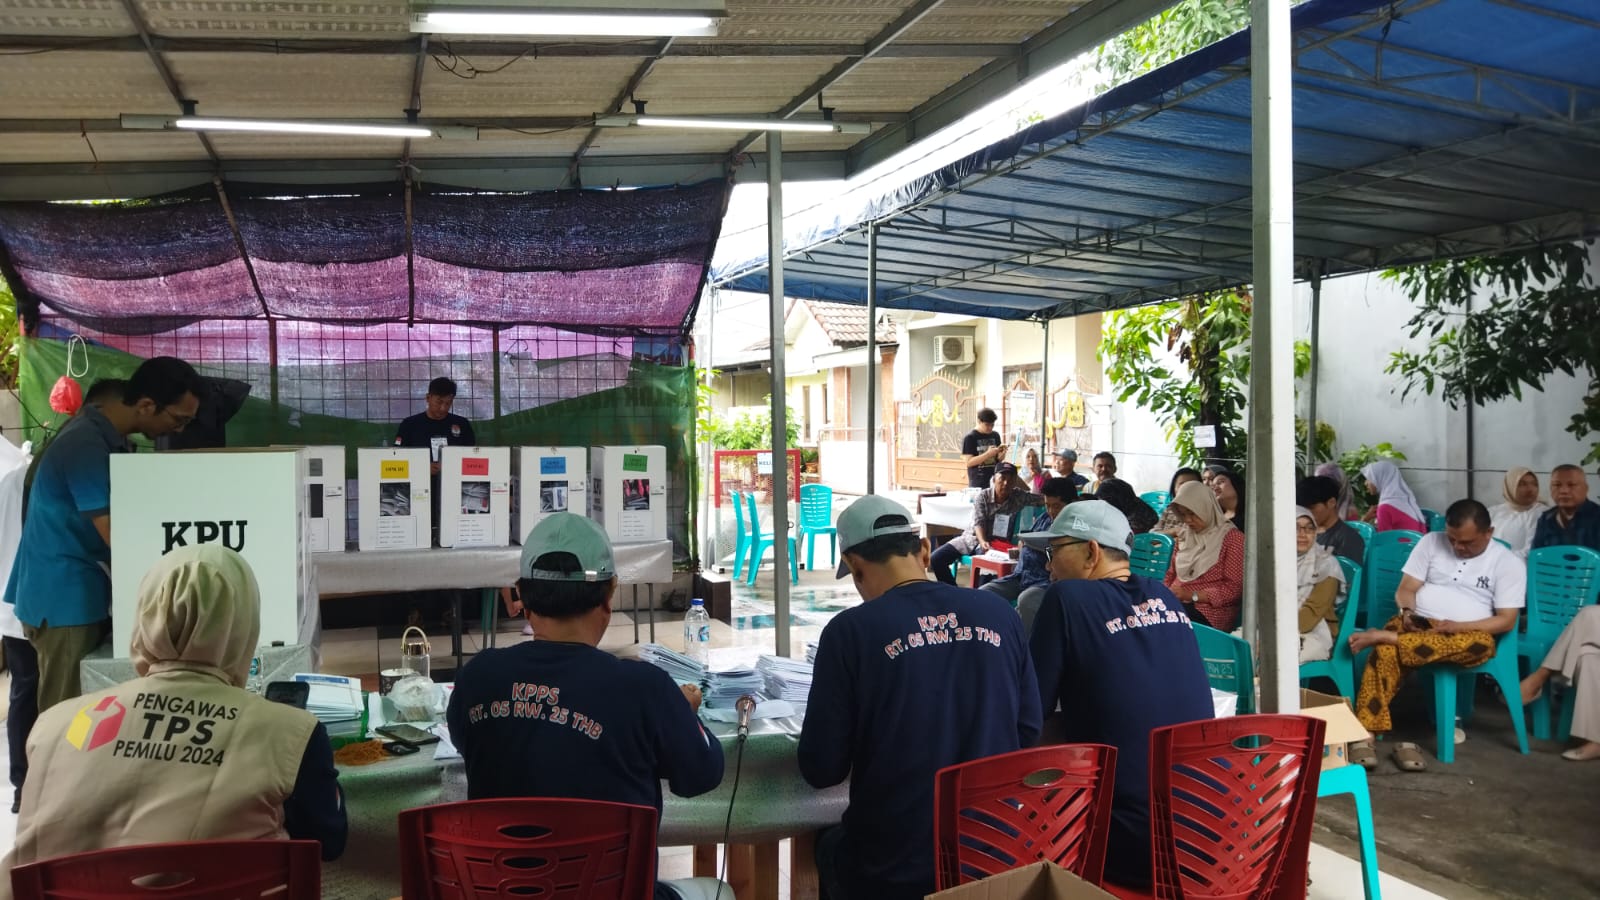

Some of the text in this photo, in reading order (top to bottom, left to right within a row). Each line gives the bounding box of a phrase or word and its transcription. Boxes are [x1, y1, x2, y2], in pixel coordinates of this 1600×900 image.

[162, 520, 247, 555] KPU
[1132, 598, 1166, 616] KPPS
[918, 613, 958, 632] KPPS
[1106, 617, 1127, 634] RT.
[885, 627, 1001, 659] RT. 05 RW. 25 THB
[133, 693, 238, 720] PENGAWAS
[512, 682, 560, 705] KPPS
[142, 712, 216, 745] TPS
[469, 701, 603, 740] RT. 05 RW. 25 THB
[113, 740, 225, 767] PEMILU 2024
